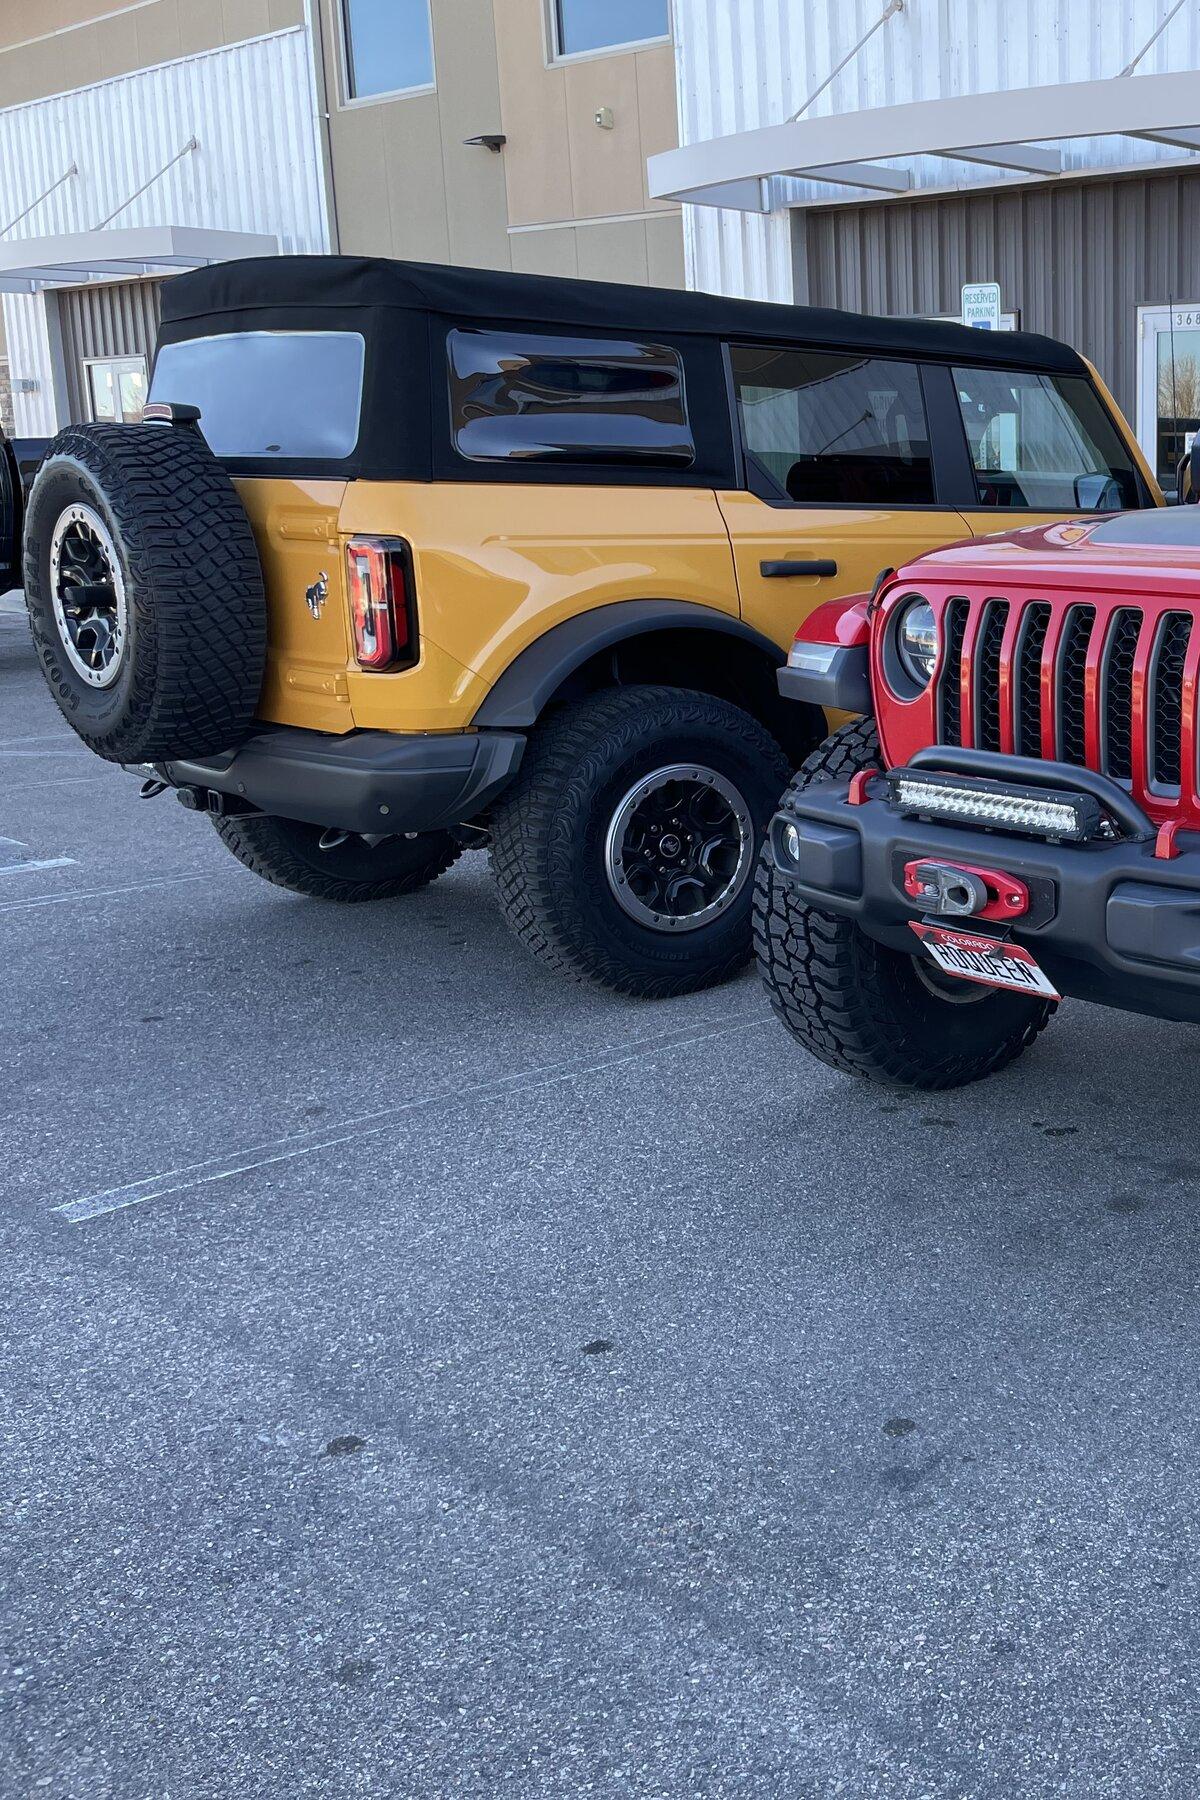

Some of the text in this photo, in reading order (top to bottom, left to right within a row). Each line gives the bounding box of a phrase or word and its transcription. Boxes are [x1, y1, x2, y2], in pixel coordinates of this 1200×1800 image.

[964, 292, 997, 304] RESERVED
[967, 306, 995, 318] PARKING
[940, 933, 995, 951] COLORADO
[929, 943, 1040, 986] RDQUEEN
